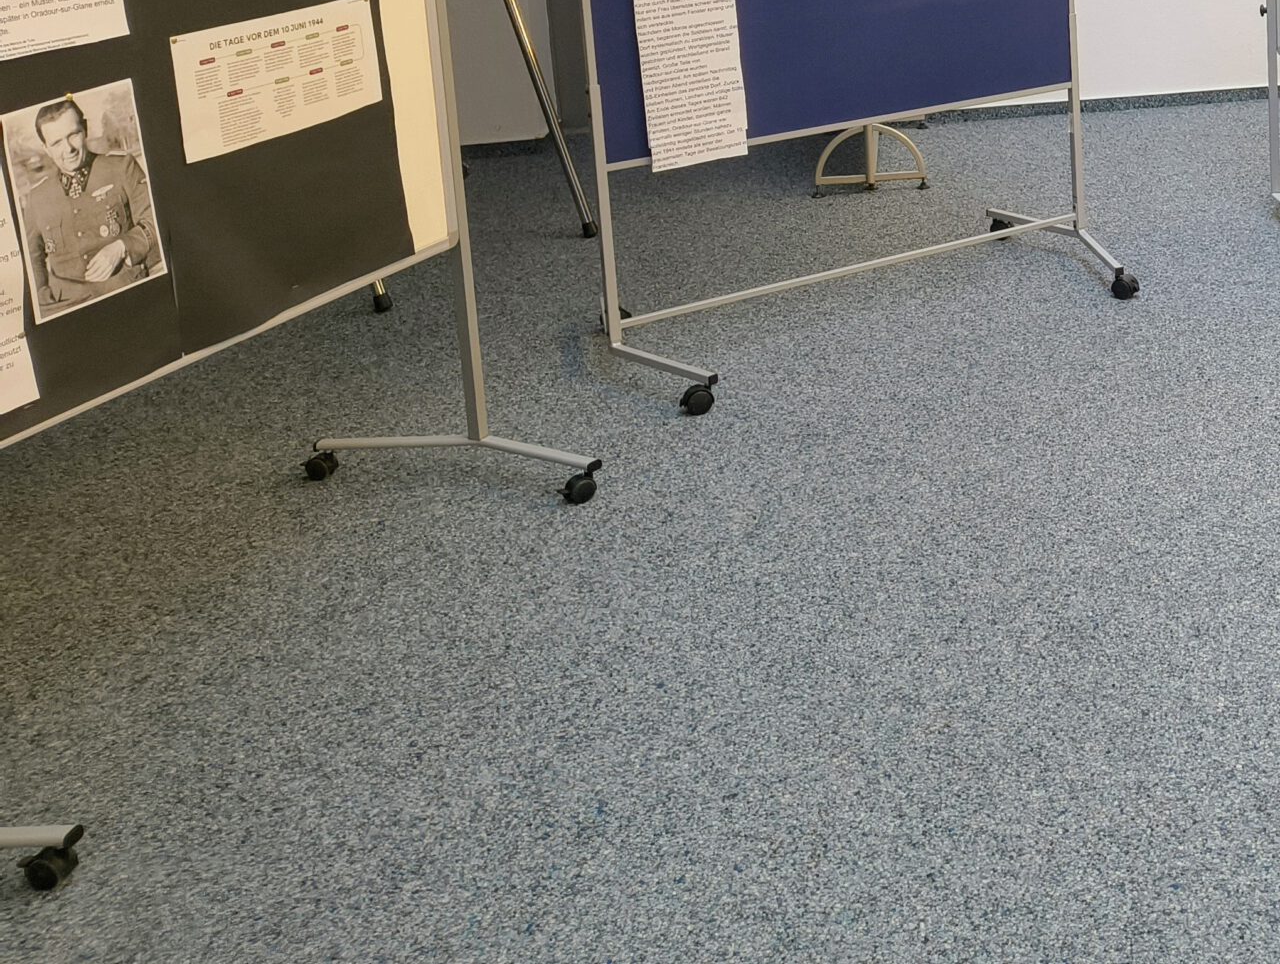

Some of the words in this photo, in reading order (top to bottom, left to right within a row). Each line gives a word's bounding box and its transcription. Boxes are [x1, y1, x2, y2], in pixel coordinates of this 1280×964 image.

[30, 2, 93, 18] Oradour-sur-Glane
[209, 40, 222, 51] DIE
[223, 35, 245, 47] TAGE
[246, 31, 262, 42] VOR
[263, 28, 280, 39] DEM
[281, 26, 289, 35] 10
[290, 22, 307, 32] JUNI
[308, 18, 323, 28] 1944
